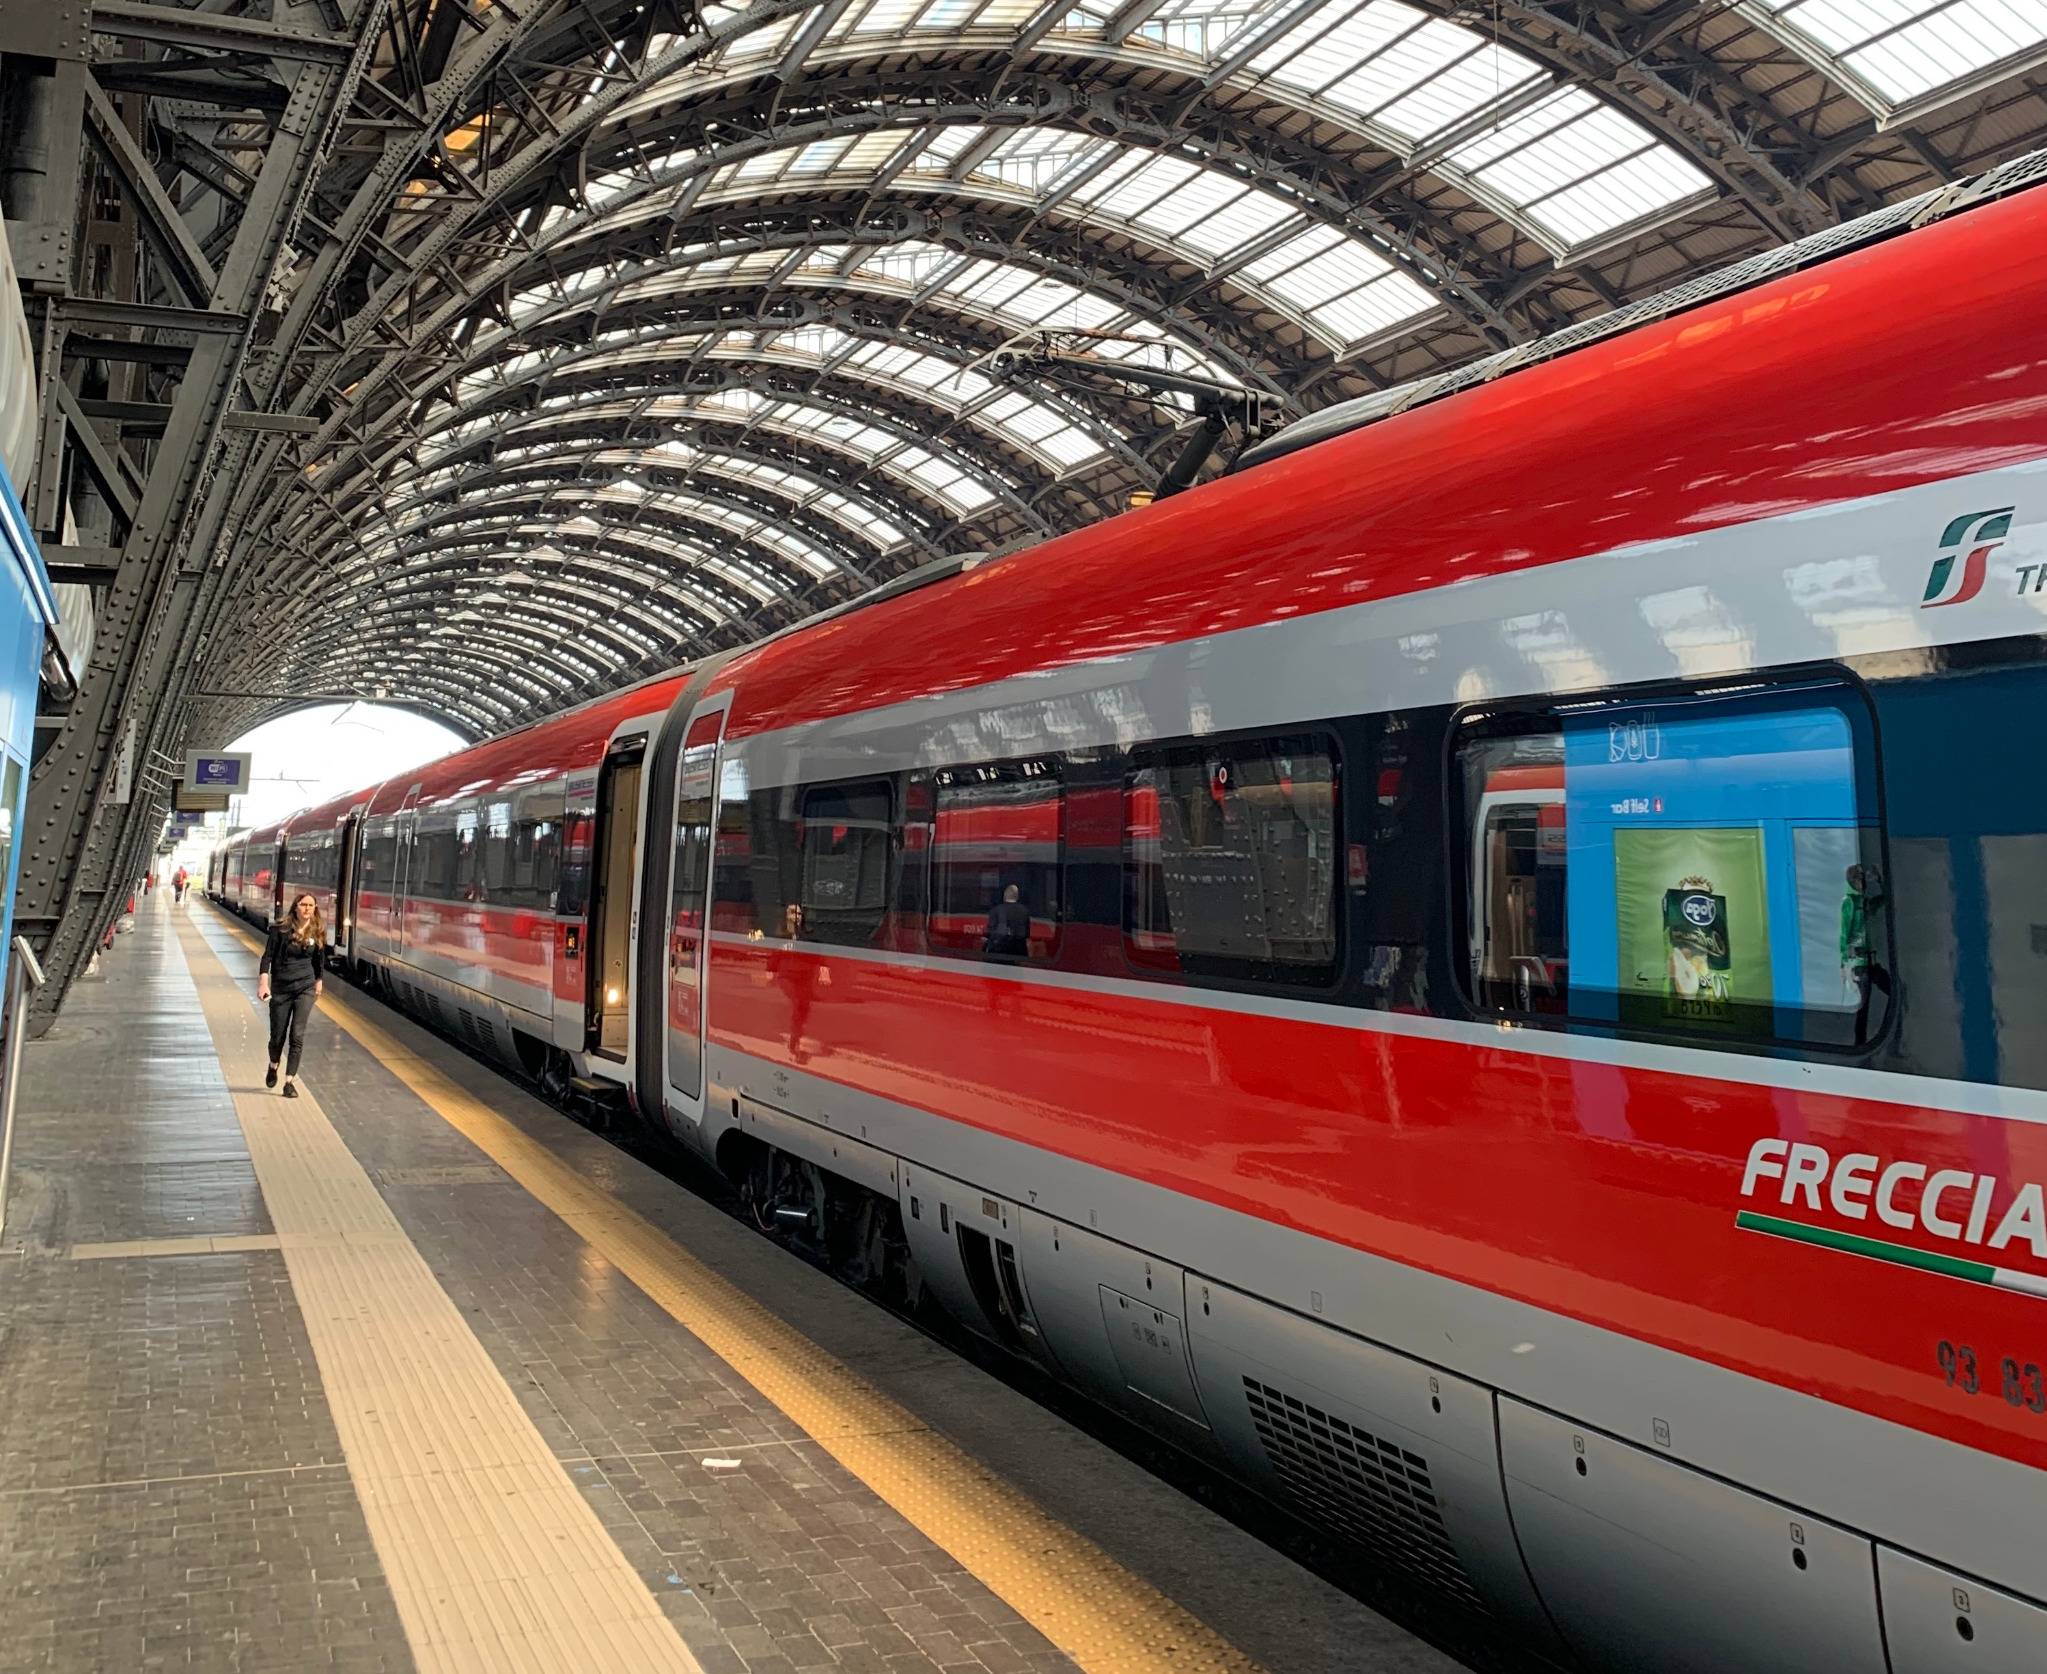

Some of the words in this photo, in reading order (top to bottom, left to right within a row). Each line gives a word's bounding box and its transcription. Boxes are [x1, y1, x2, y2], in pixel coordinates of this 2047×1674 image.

[1740, 1137, 2047, 1259] FRECCIA
[1936, 1338, 1980, 1395] 93
[2001, 1356, 2046, 1413] 83
